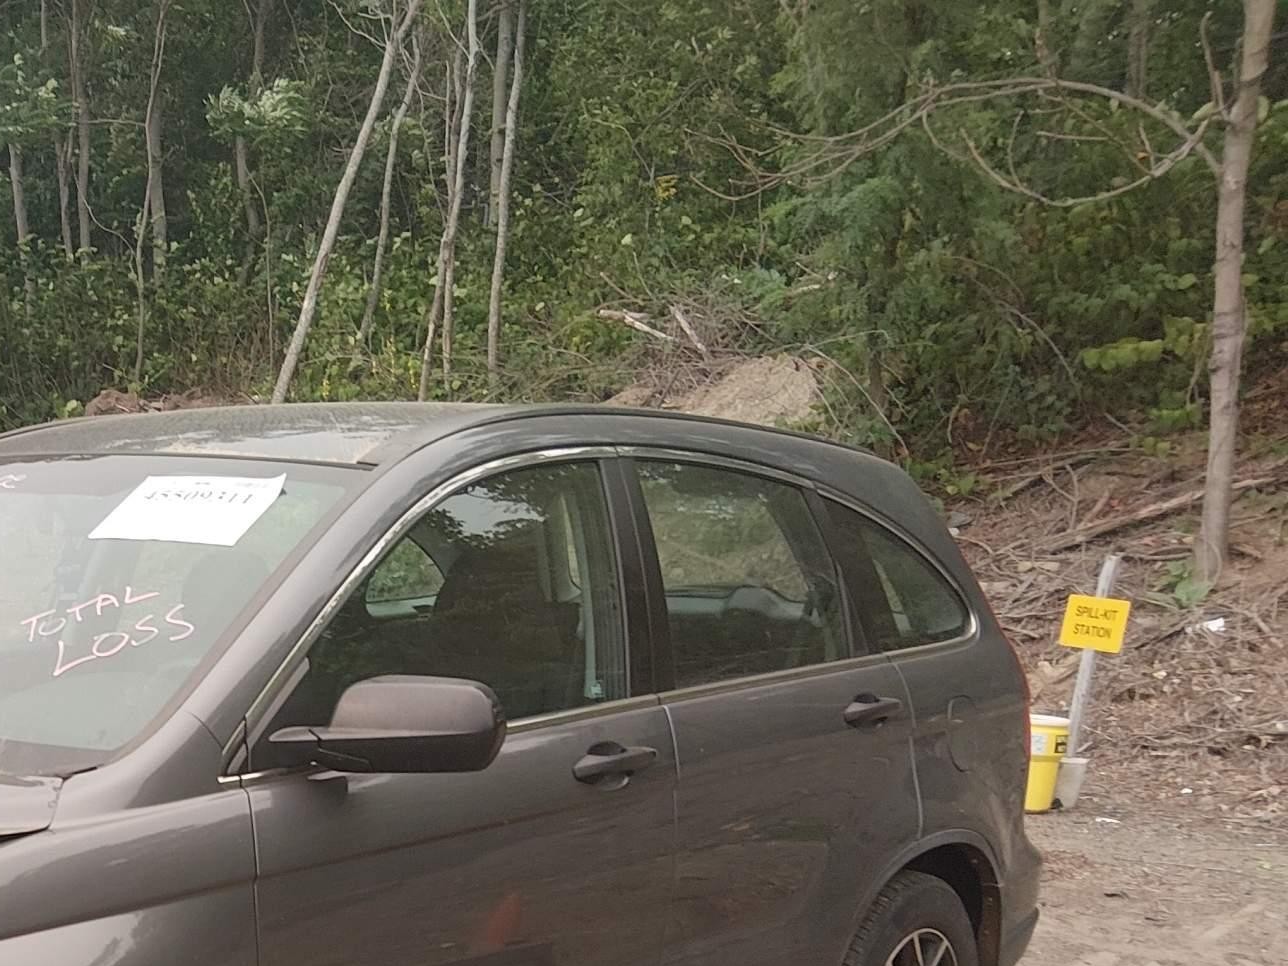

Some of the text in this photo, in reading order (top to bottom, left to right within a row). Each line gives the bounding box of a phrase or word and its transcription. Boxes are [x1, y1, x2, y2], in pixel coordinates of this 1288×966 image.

[20, 586, 161, 642] TOTAL
[1072, 623, 1113, 639] STATION
[1074, 605, 1119, 621] SPILL-KIT
[52, 604, 195, 676] LOSS
